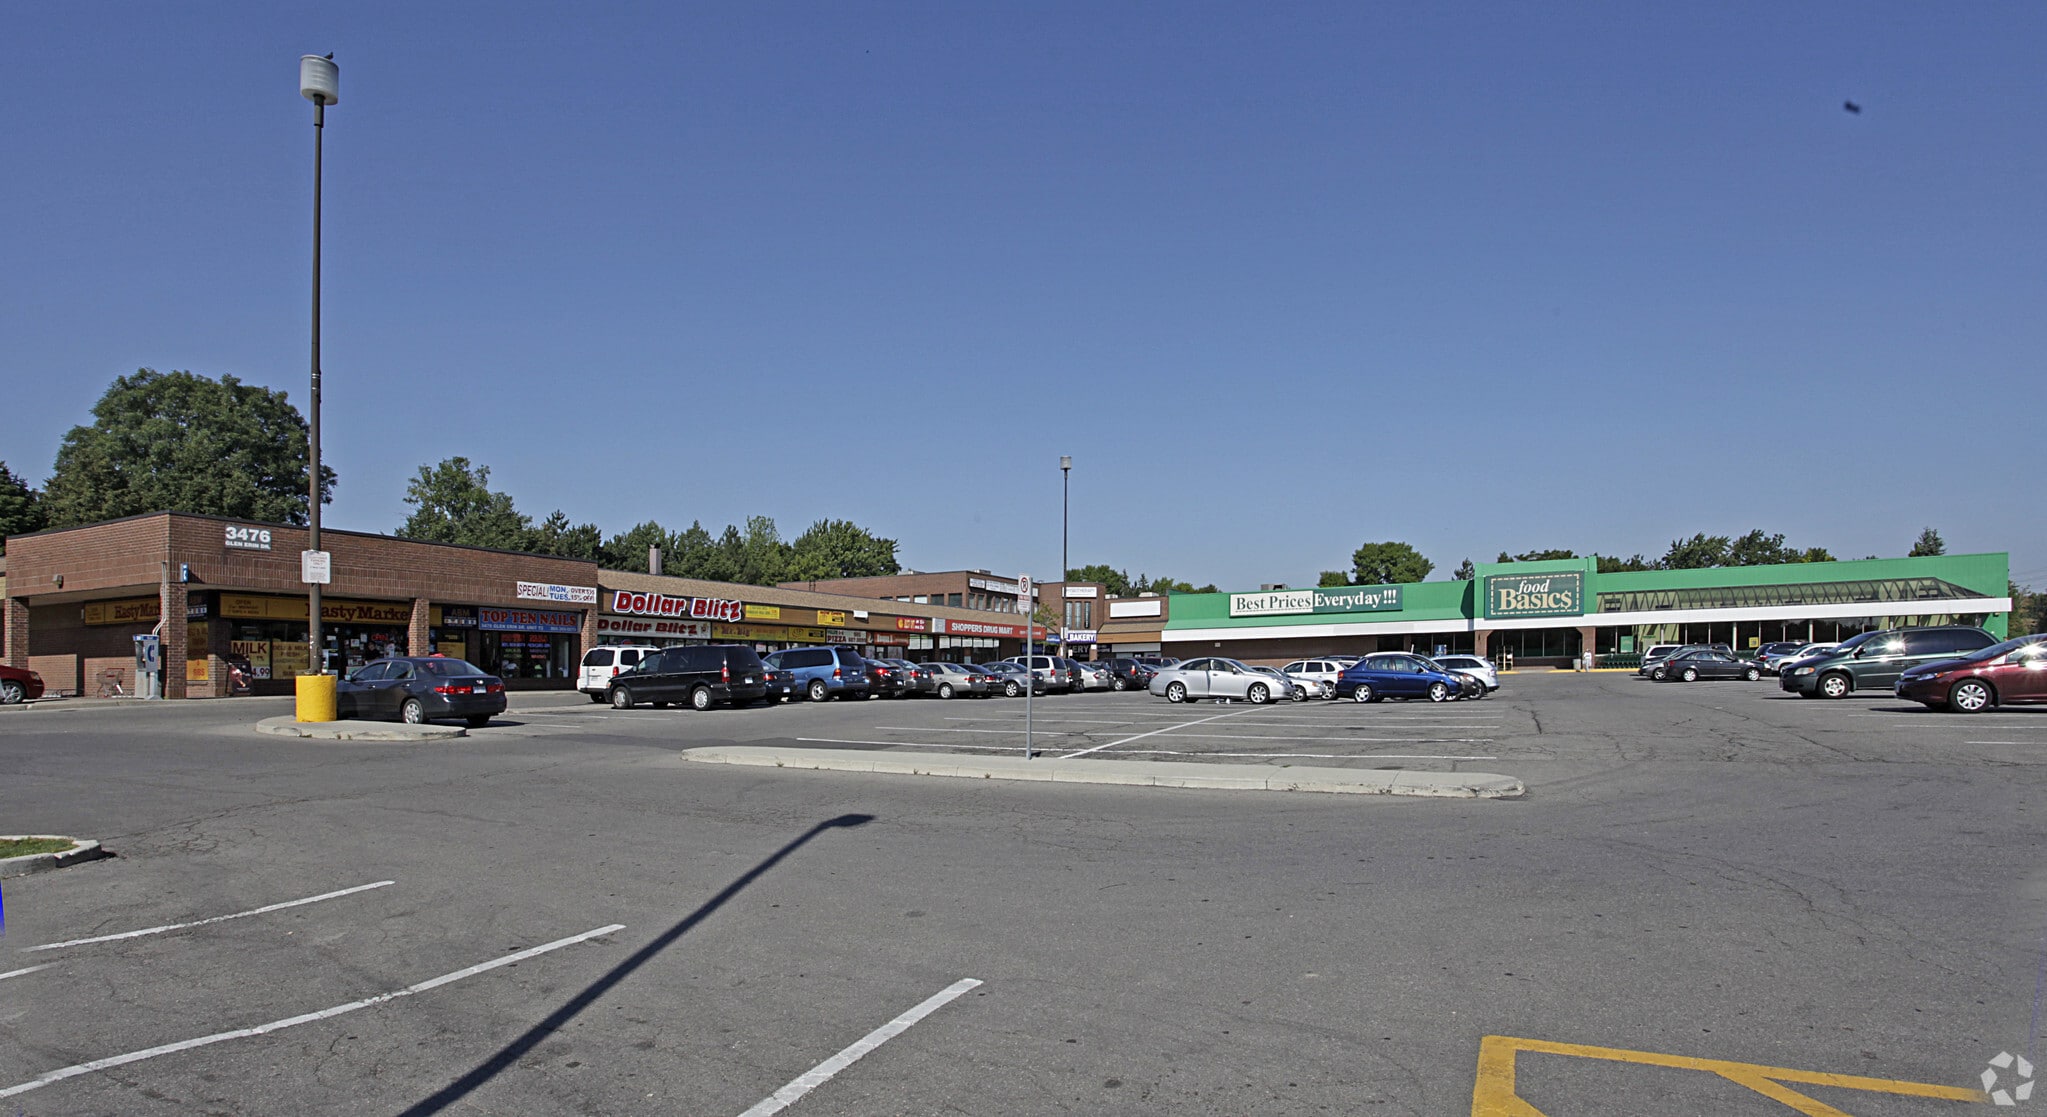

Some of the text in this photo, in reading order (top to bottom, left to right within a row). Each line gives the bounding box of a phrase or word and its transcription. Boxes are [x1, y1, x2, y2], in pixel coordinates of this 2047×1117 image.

[225, 527, 271, 542] 3476
[1516, 579, 1550, 594] food
[614, 591, 687, 616] Dollar
[690, 598, 741, 622] Blitz
[1236, 597, 1264, 610] Best
[1269, 595, 1311, 609] Prices
[482, 610, 508, 622] TOP
[512, 612, 536, 624] TEN
[540, 613, 577, 626] NAILS
[598, 619, 697, 637] Dollar Blitz
[951, 622, 983, 633] SHOPPERS
[983, 625, 998, 634] DRUG
[999, 626, 1013, 634] MART
[233, 642, 267, 655] MILK
